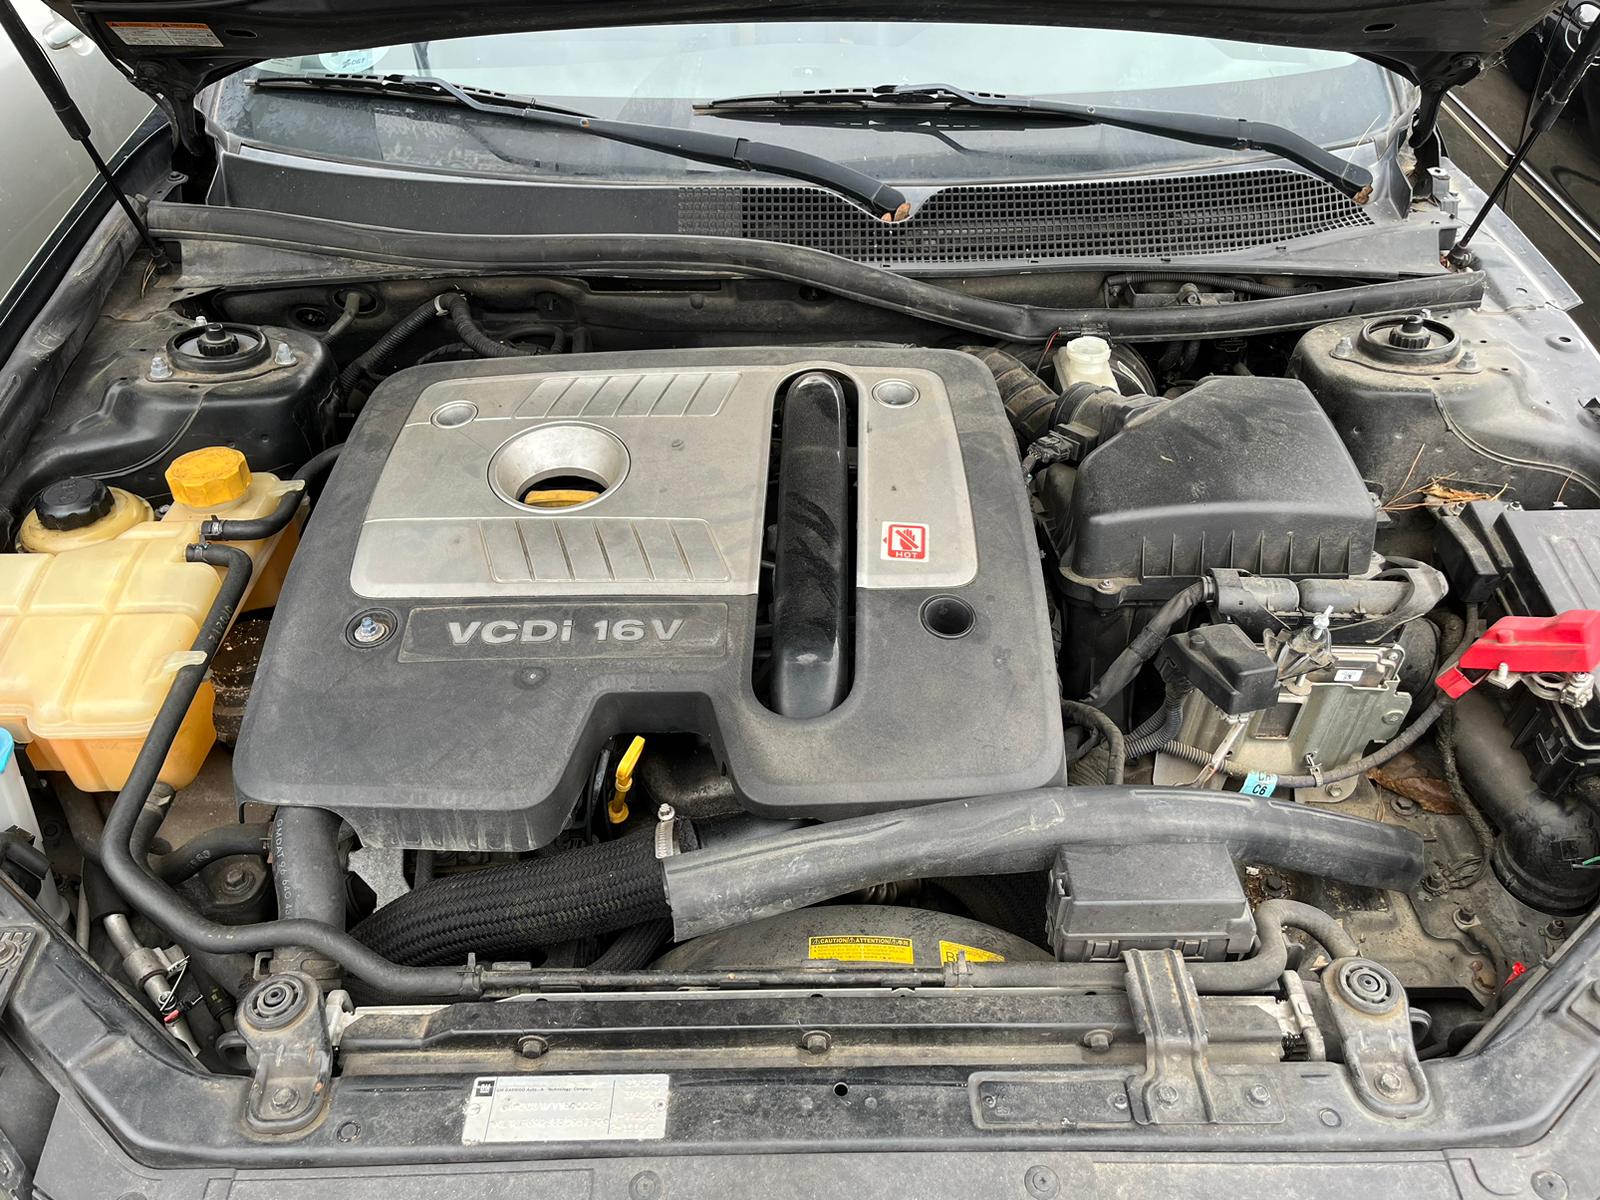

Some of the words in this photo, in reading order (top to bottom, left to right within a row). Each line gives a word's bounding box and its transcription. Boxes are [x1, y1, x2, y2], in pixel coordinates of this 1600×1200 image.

[449, 619, 574, 644] VCDi
[594, 619, 685, 642] 16V
[1252, 783, 1268, 796] C6
[275, 818, 285, 858] GMDAT
[279, 860, 288, 875] 96
